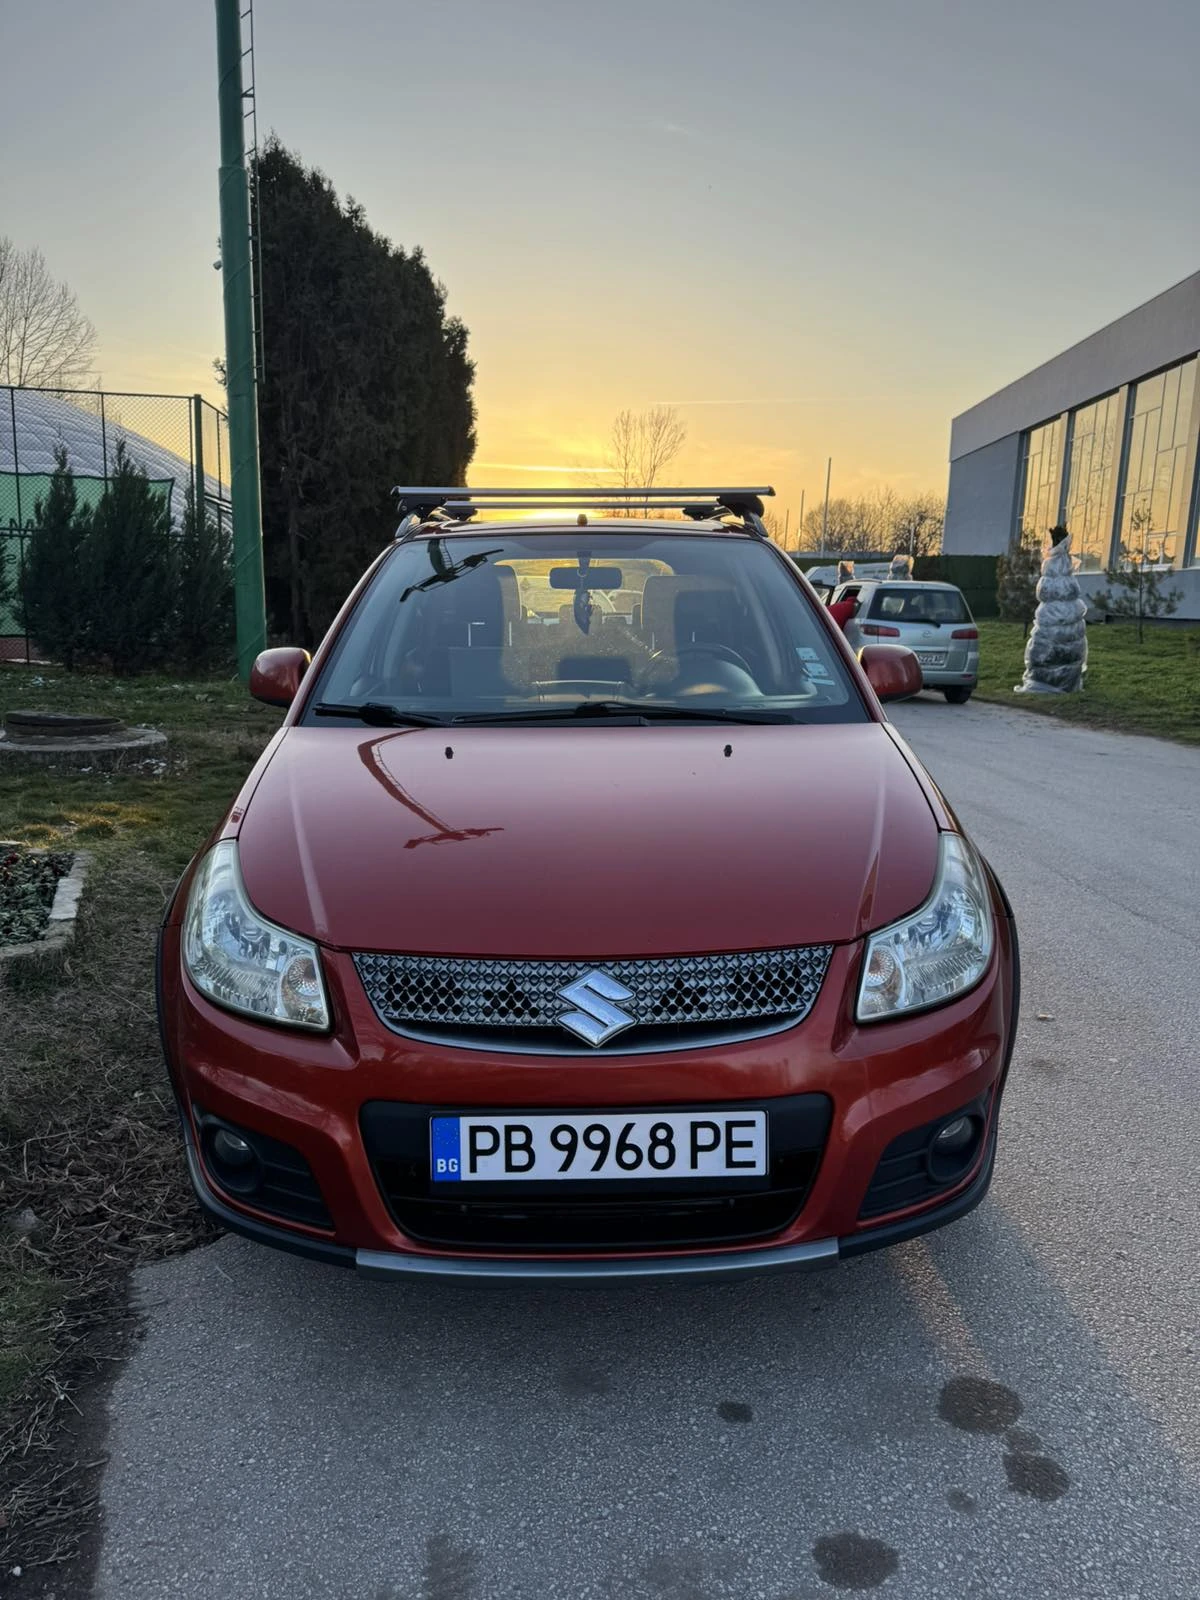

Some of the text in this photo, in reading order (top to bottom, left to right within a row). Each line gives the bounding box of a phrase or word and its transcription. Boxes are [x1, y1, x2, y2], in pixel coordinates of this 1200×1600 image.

[469, 1120, 756, 1173] PB 9968 PE
[437, 1158, 458, 1173] BG
